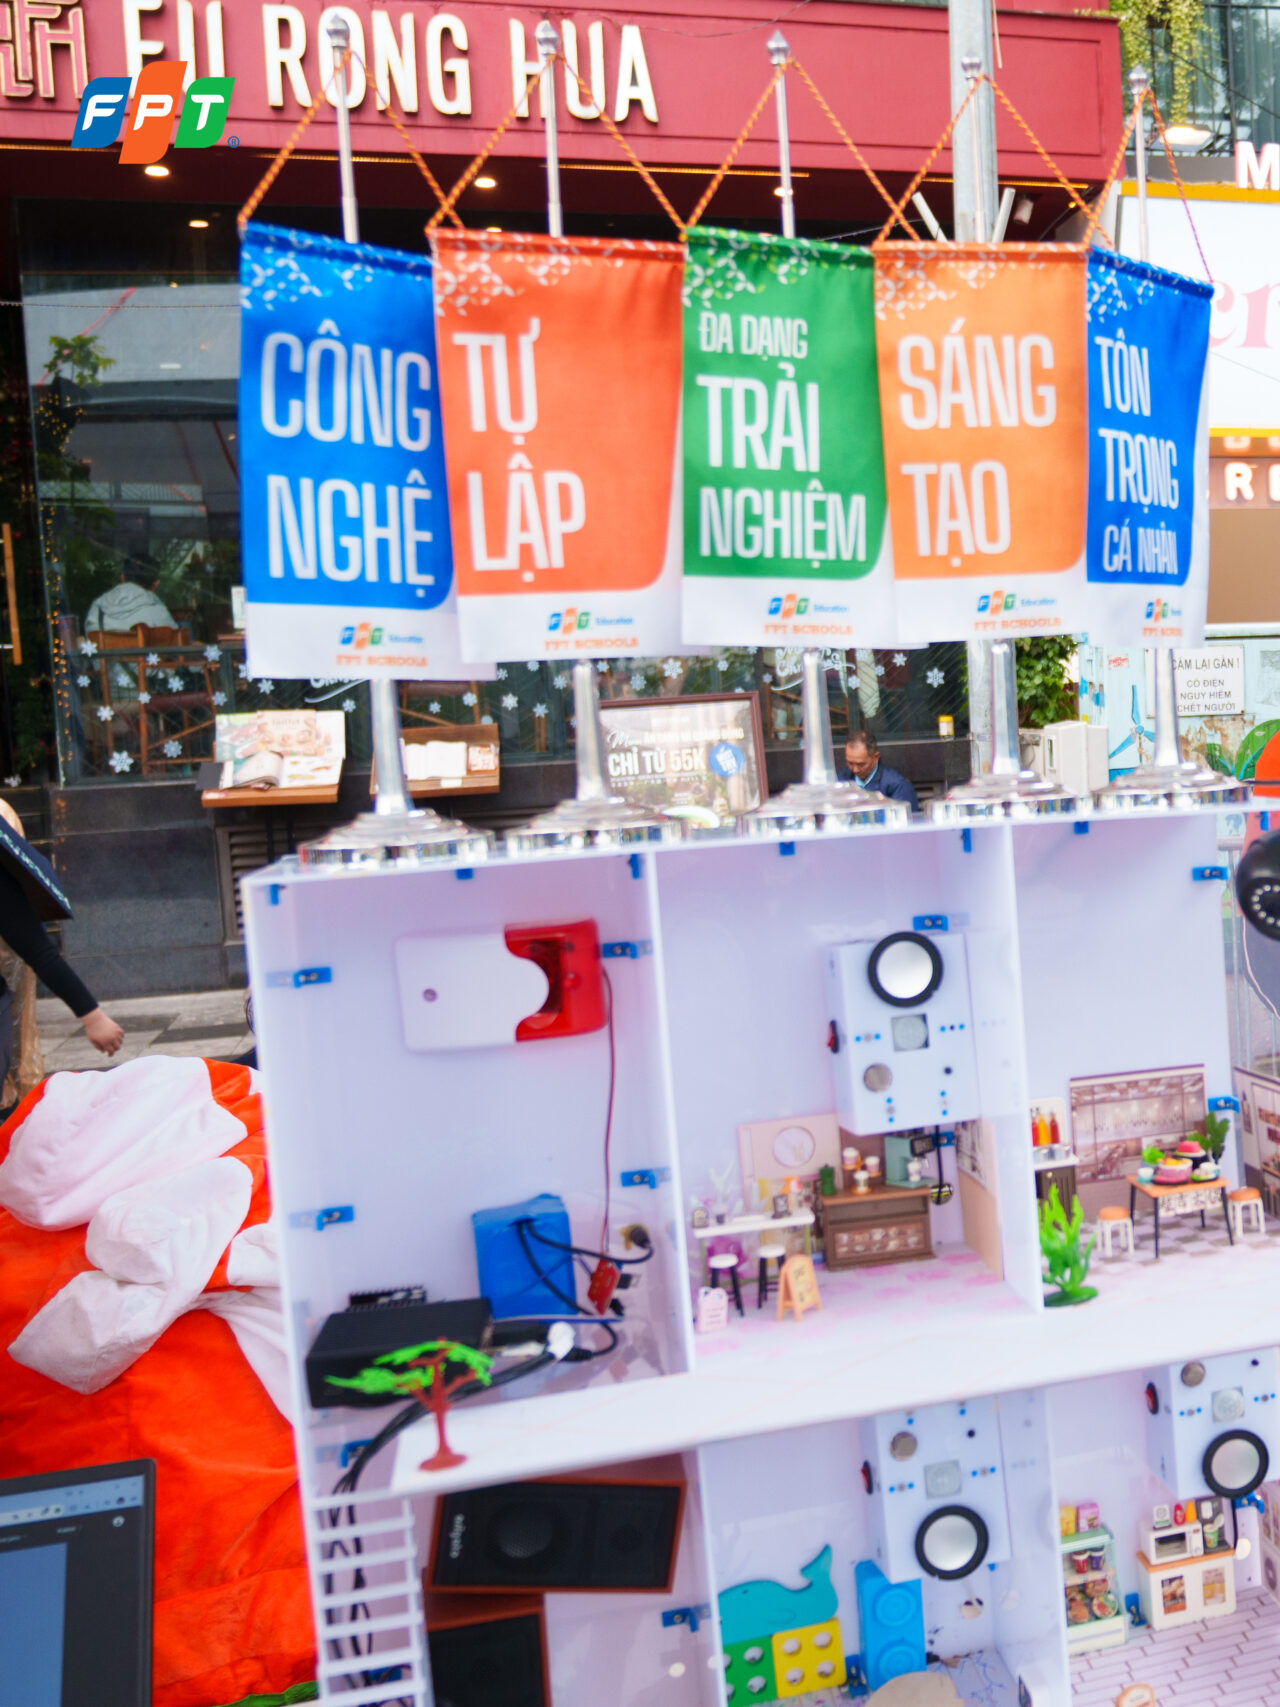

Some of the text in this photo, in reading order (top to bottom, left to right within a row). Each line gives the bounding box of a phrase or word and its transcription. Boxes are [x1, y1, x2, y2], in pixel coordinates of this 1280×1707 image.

[261, 3, 472, 115] RONG
[509, 19, 659, 123] HUA
[699, 311, 808, 361] ĐA DẠNG
[899, 317, 1057, 430] SÁNG
[1093, 329, 1152, 417] TÔN
[260, 319, 432, 452] CÔNG
[451, 317, 542, 446] TỰ
[696, 361, 821, 474] TRẢI
[901, 460, 1011, 567] TẠO
[1098, 428, 1179, 515] TRỌNG
[266, 469, 436, 598] NGHỆ
[467, 452, 586, 583] LẬP
[699, 479, 867, 568] NGHIỆM
[1103, 521, 1179, 575] CÁ NHÂN
[340, 623, 385, 651] FPT
[547, 608, 591, 634] FPT
[767, 593, 809, 618] FPT
[976, 590, 1018, 616] FPT
[1180, 691, 1206, 701] NGUY
[607, 746, 639, 777] CHỈ
[669, 747, 707, 773] 55K
